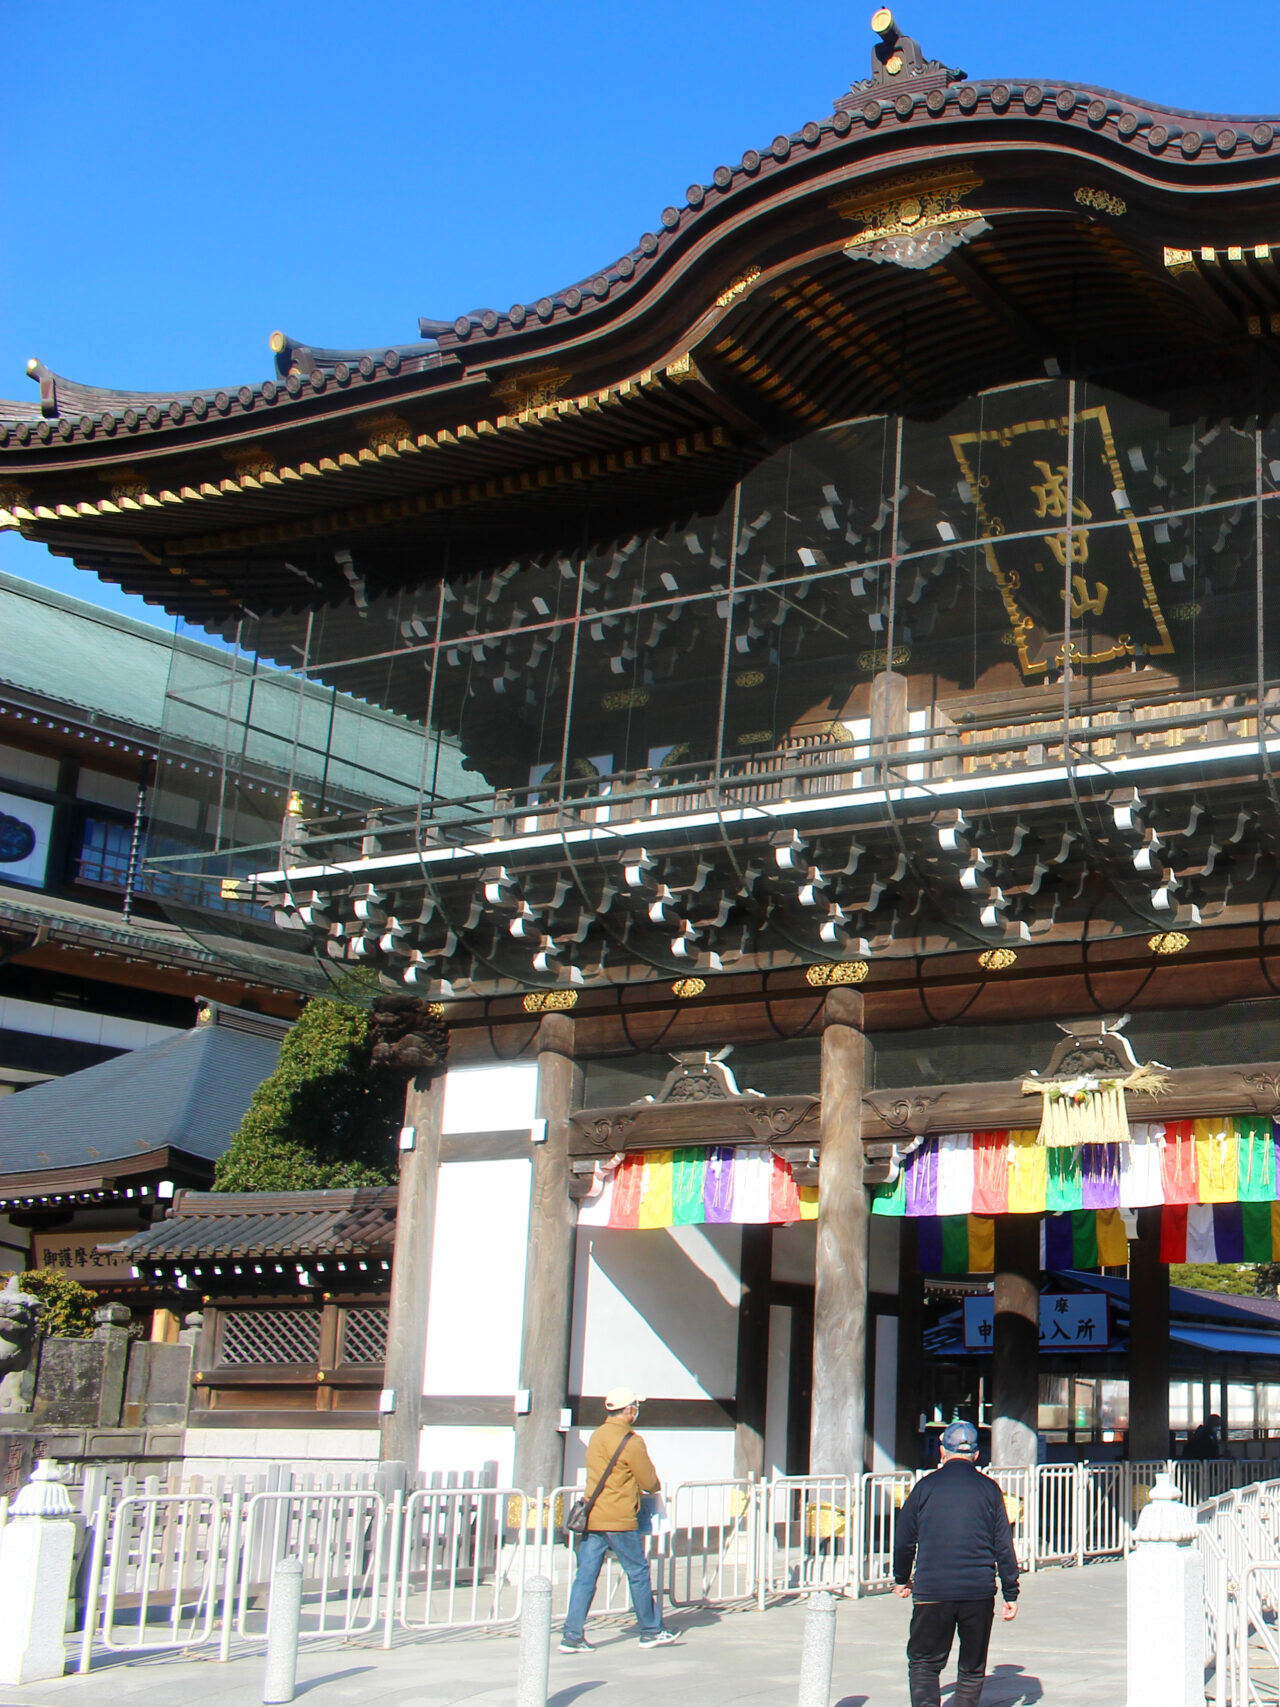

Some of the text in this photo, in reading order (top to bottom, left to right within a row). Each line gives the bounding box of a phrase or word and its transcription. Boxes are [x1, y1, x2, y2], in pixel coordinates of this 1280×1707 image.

[1030, 460, 1109, 619] 成田山
[43, 1247, 131, 1268] 御護摩受
[977, 1318, 1096, 1344] 申入所
